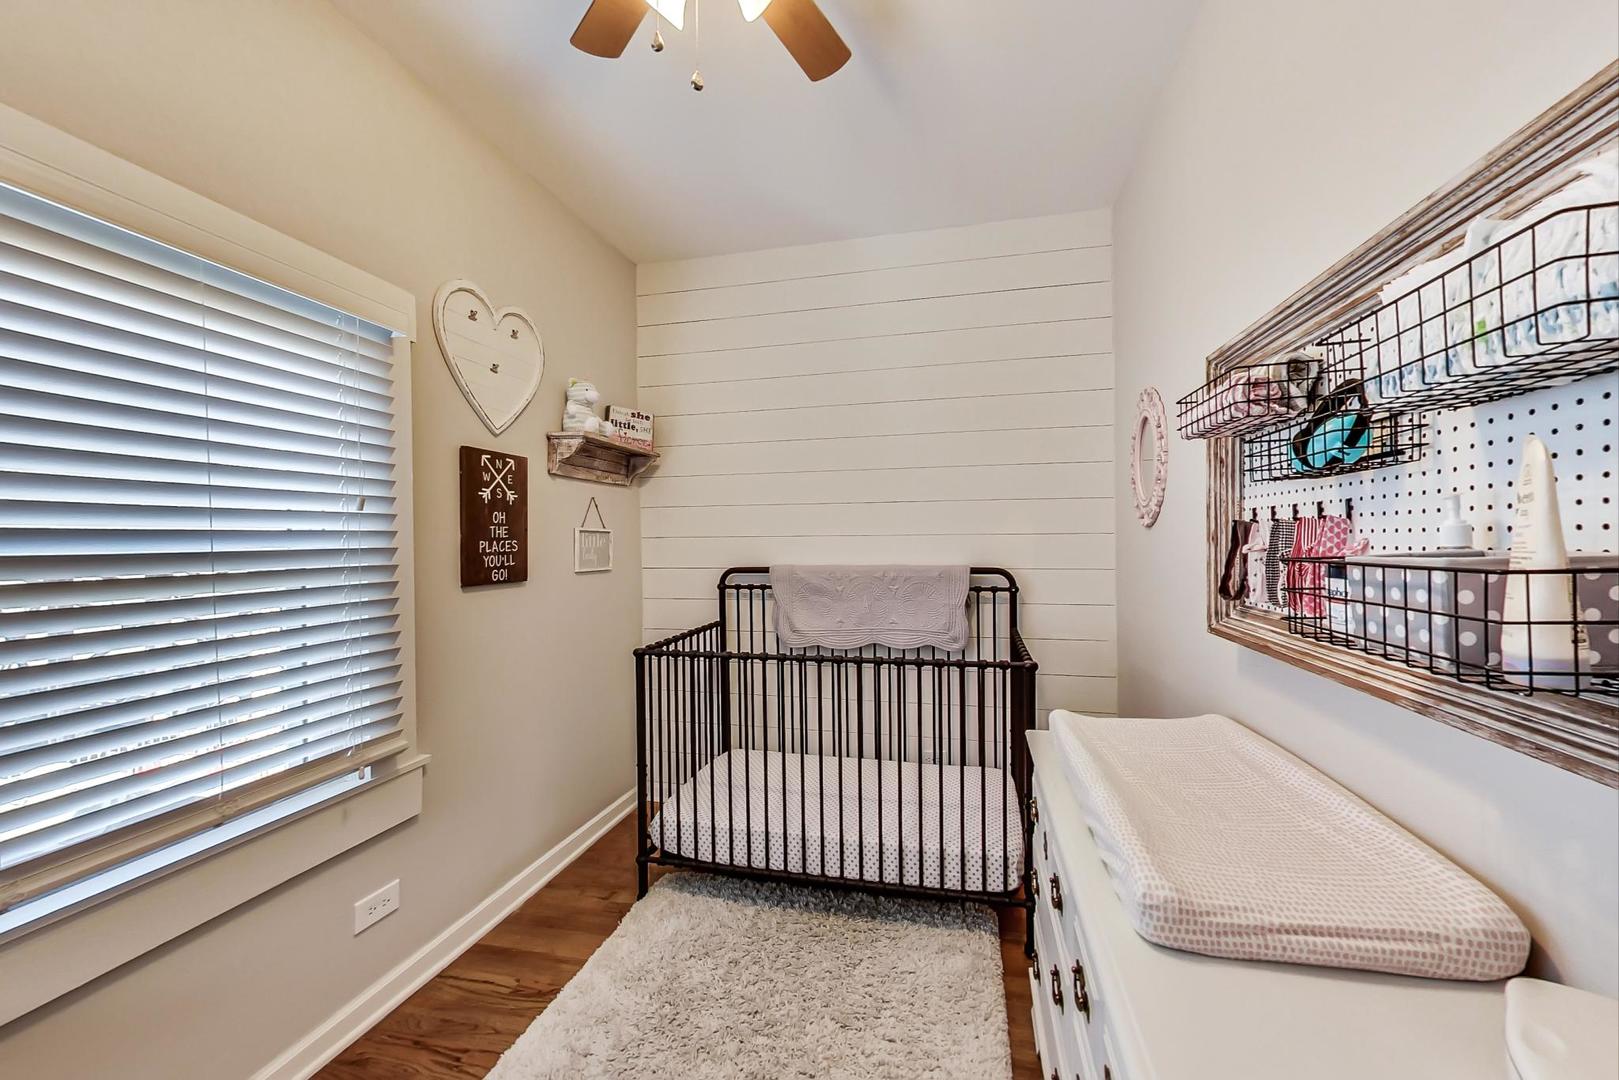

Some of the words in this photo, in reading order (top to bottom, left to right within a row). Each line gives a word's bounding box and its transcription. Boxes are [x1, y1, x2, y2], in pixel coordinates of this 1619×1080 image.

[630, 411, 651, 421] she
[495, 459, 503, 469] N
[482, 472, 491, 482] W
[507, 474, 513, 485] E
[496, 488, 503, 498] S
[492, 511, 506, 524] OH
[489, 526, 509, 538] THE
[479, 540, 518, 553] PLACES
[483, 554, 516, 567] YOU'LL
[491, 568, 508, 582] GO!
